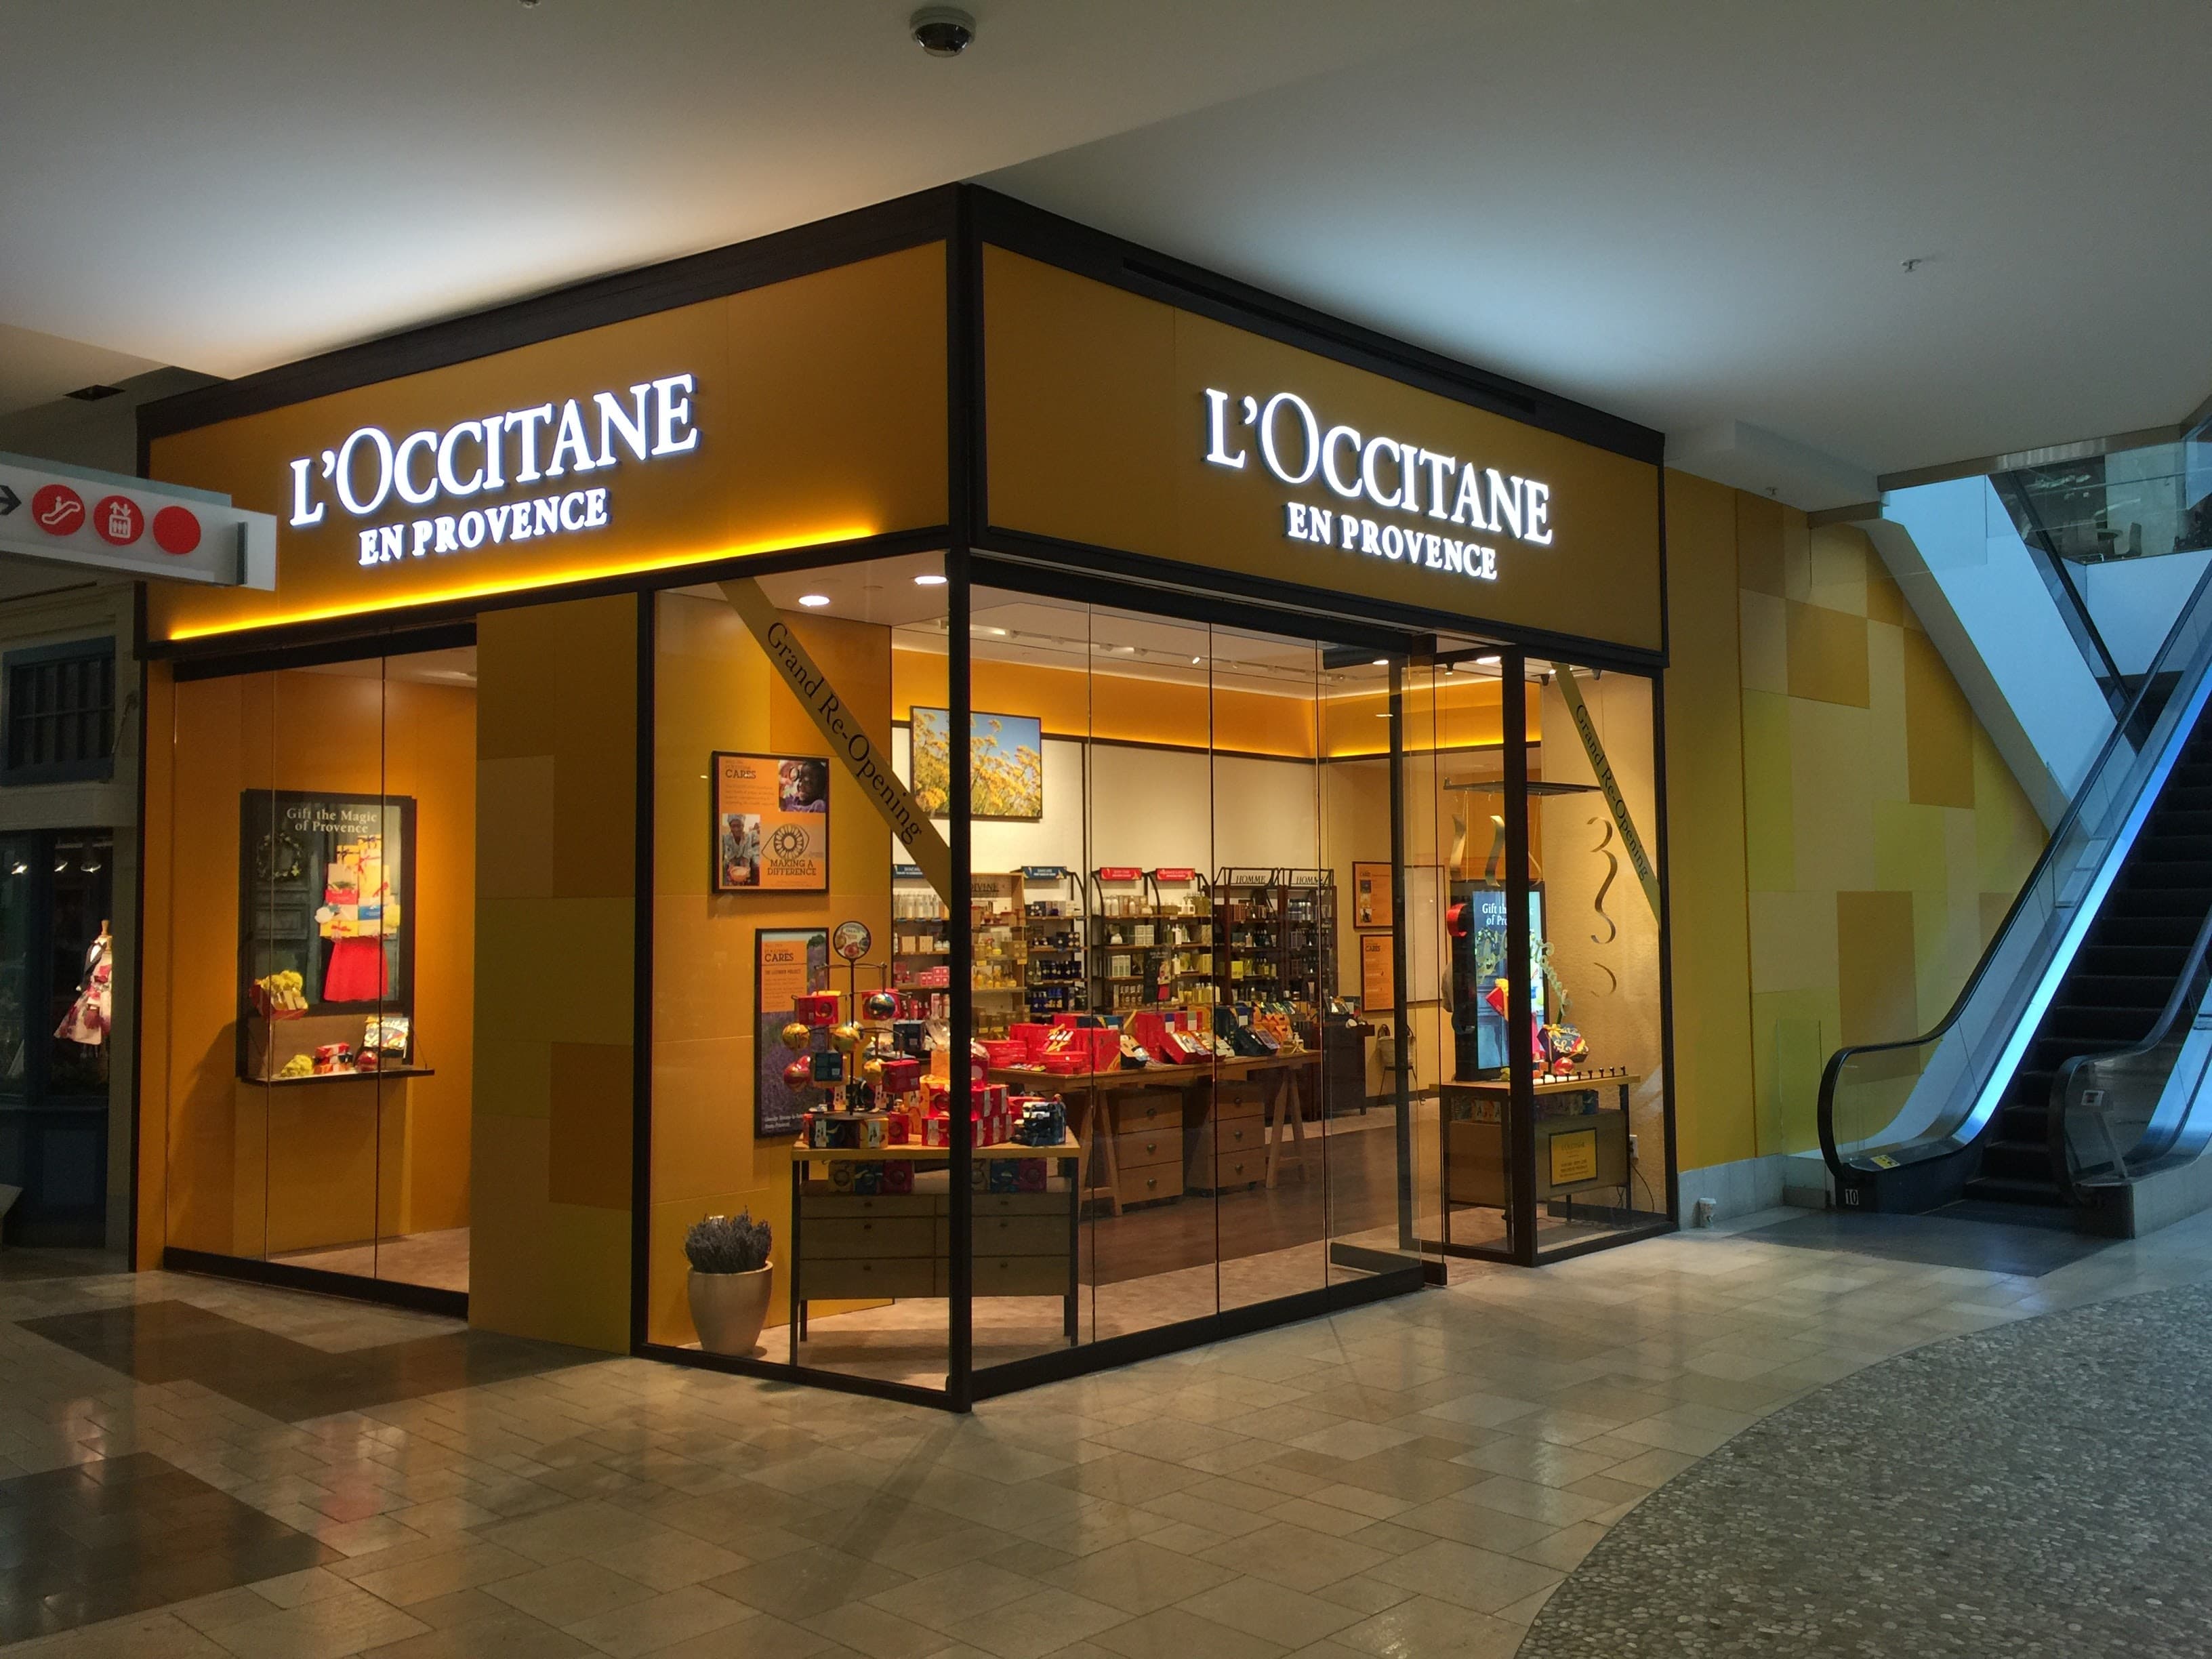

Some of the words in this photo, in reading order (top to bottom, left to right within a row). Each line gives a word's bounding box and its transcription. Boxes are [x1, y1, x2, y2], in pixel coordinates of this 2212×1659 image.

[289, 373, 699, 527] L'OCCITANE
[1205, 387, 1553, 545] L'OCCITANE
[358, 523, 405, 566] EN
[411, 487, 609, 558] PROVENCE
[1287, 501, 1333, 546] EN
[1340, 514, 1498, 581] PROVENCE
[767, 621, 825, 699] Grand
[817, 693, 922, 845] Re-Opening
[725, 769, 756, 779] CARES
[1576, 704, 1605, 766] Grand
[1601, 767, 1649, 882] Re-Opening
[287, 808, 311, 819] Gift
[316, 809, 337, 821] the
[341, 811, 377, 824] Magic
[295, 820, 309, 832] of
[312, 821, 369, 834] Provence
[770, 859, 805, 867] MAKING
[808, 859, 813, 867] A
[767, 867, 817, 876] DIFFERENCE
[1482, 903, 1496, 914] Gift
[1487, 914, 1495, 926] of
[764, 953, 794, 962] CARES
[1846, 1189, 1858, 1204] 10
